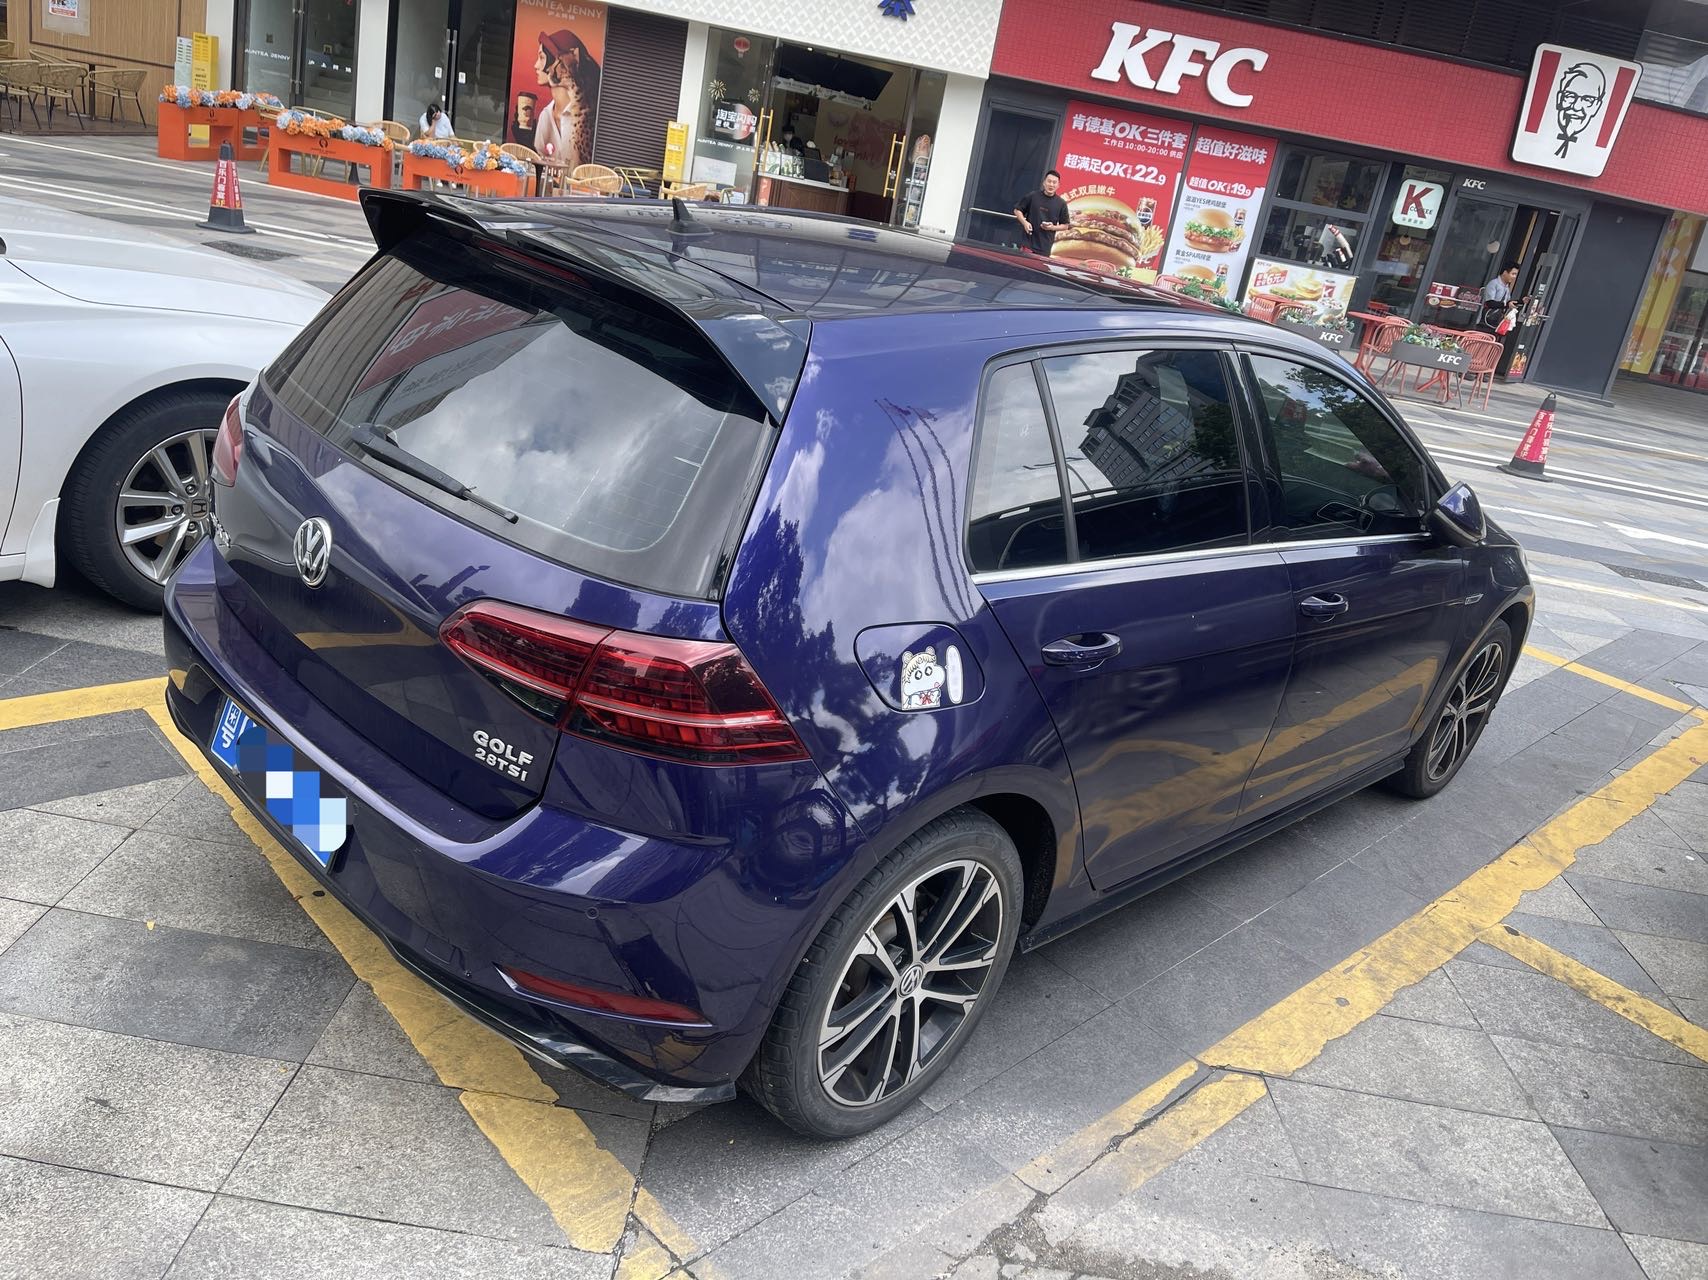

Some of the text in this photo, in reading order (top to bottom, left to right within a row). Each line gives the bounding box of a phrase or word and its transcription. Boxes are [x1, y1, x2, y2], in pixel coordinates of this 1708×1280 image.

[568, 4, 602, 18] JENNY
[1090, 21, 1269, 107] KFC
[716, 109, 757, 126] 淘宝闪购
[1072, 114, 1188, 149] 肯德基OK三件套
[1125, 142, 1168, 156] 10:00-20:00
[1195, 137, 1267, 164] 超值好滋味
[1064, 153, 1127, 178] 超满足OK
[1189, 176, 1228, 192] 超值OK
[1462, 178, 1486, 190] KFC
[1401, 184, 1434, 219] K
[1410, 206, 1433, 215] COEE
[1319, 332, 1343, 343] KFC
[1437, 353, 1462, 365] KFC
[473, 730, 534, 765] GOLF
[475, 747, 528, 782] 28TSI
